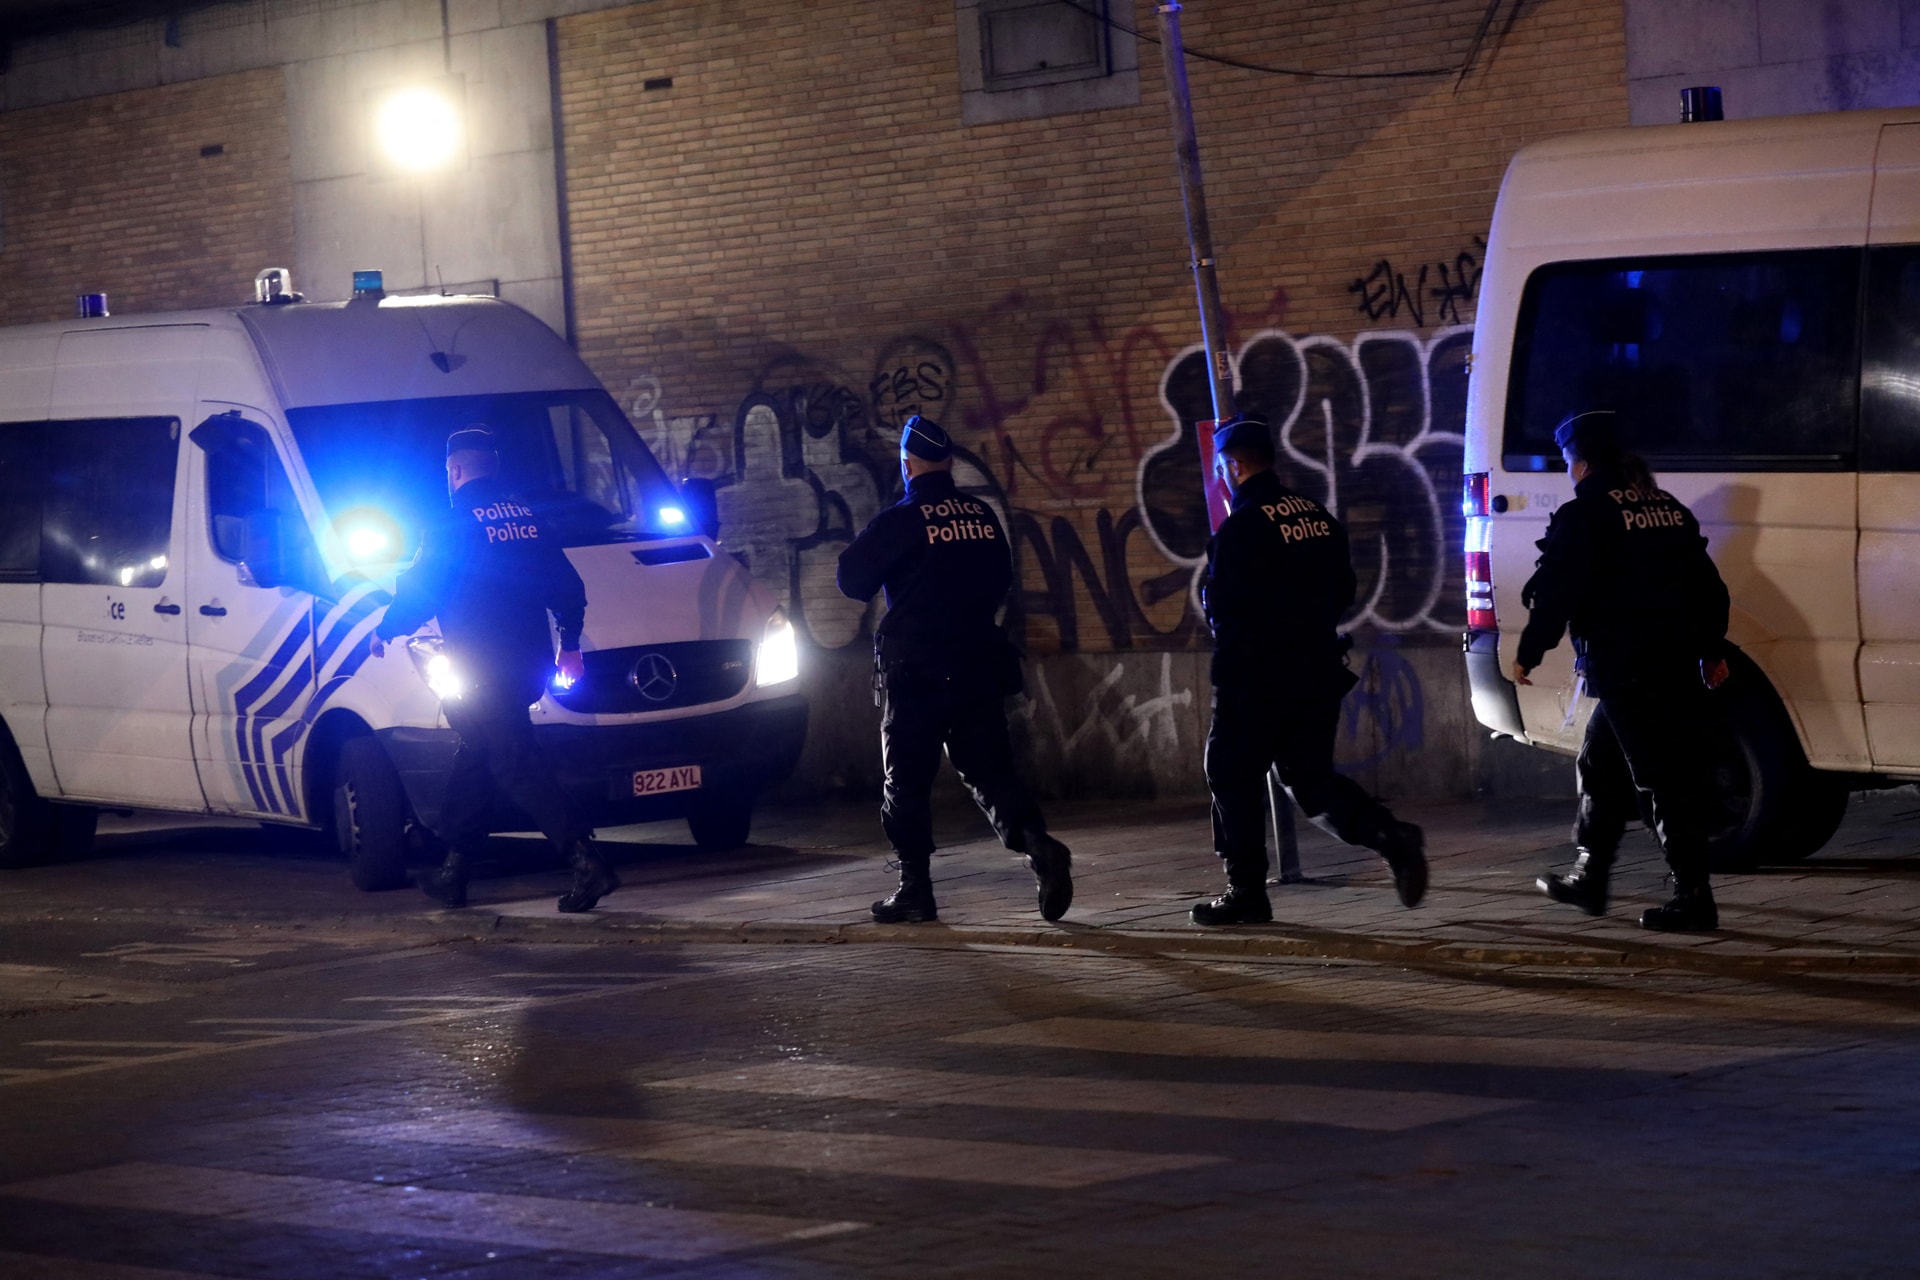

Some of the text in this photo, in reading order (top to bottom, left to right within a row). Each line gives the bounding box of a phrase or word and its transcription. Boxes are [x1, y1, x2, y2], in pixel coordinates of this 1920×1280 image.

[473, 502, 533, 522] Politie
[920, 499, 984, 520] Police
[1621, 505, 1684, 531] Politie
[485, 522, 538, 543] Police
[926, 519, 995, 545] Politie
[1279, 517, 1330, 544] Police
[635, 768, 700, 793] 922 AYL
